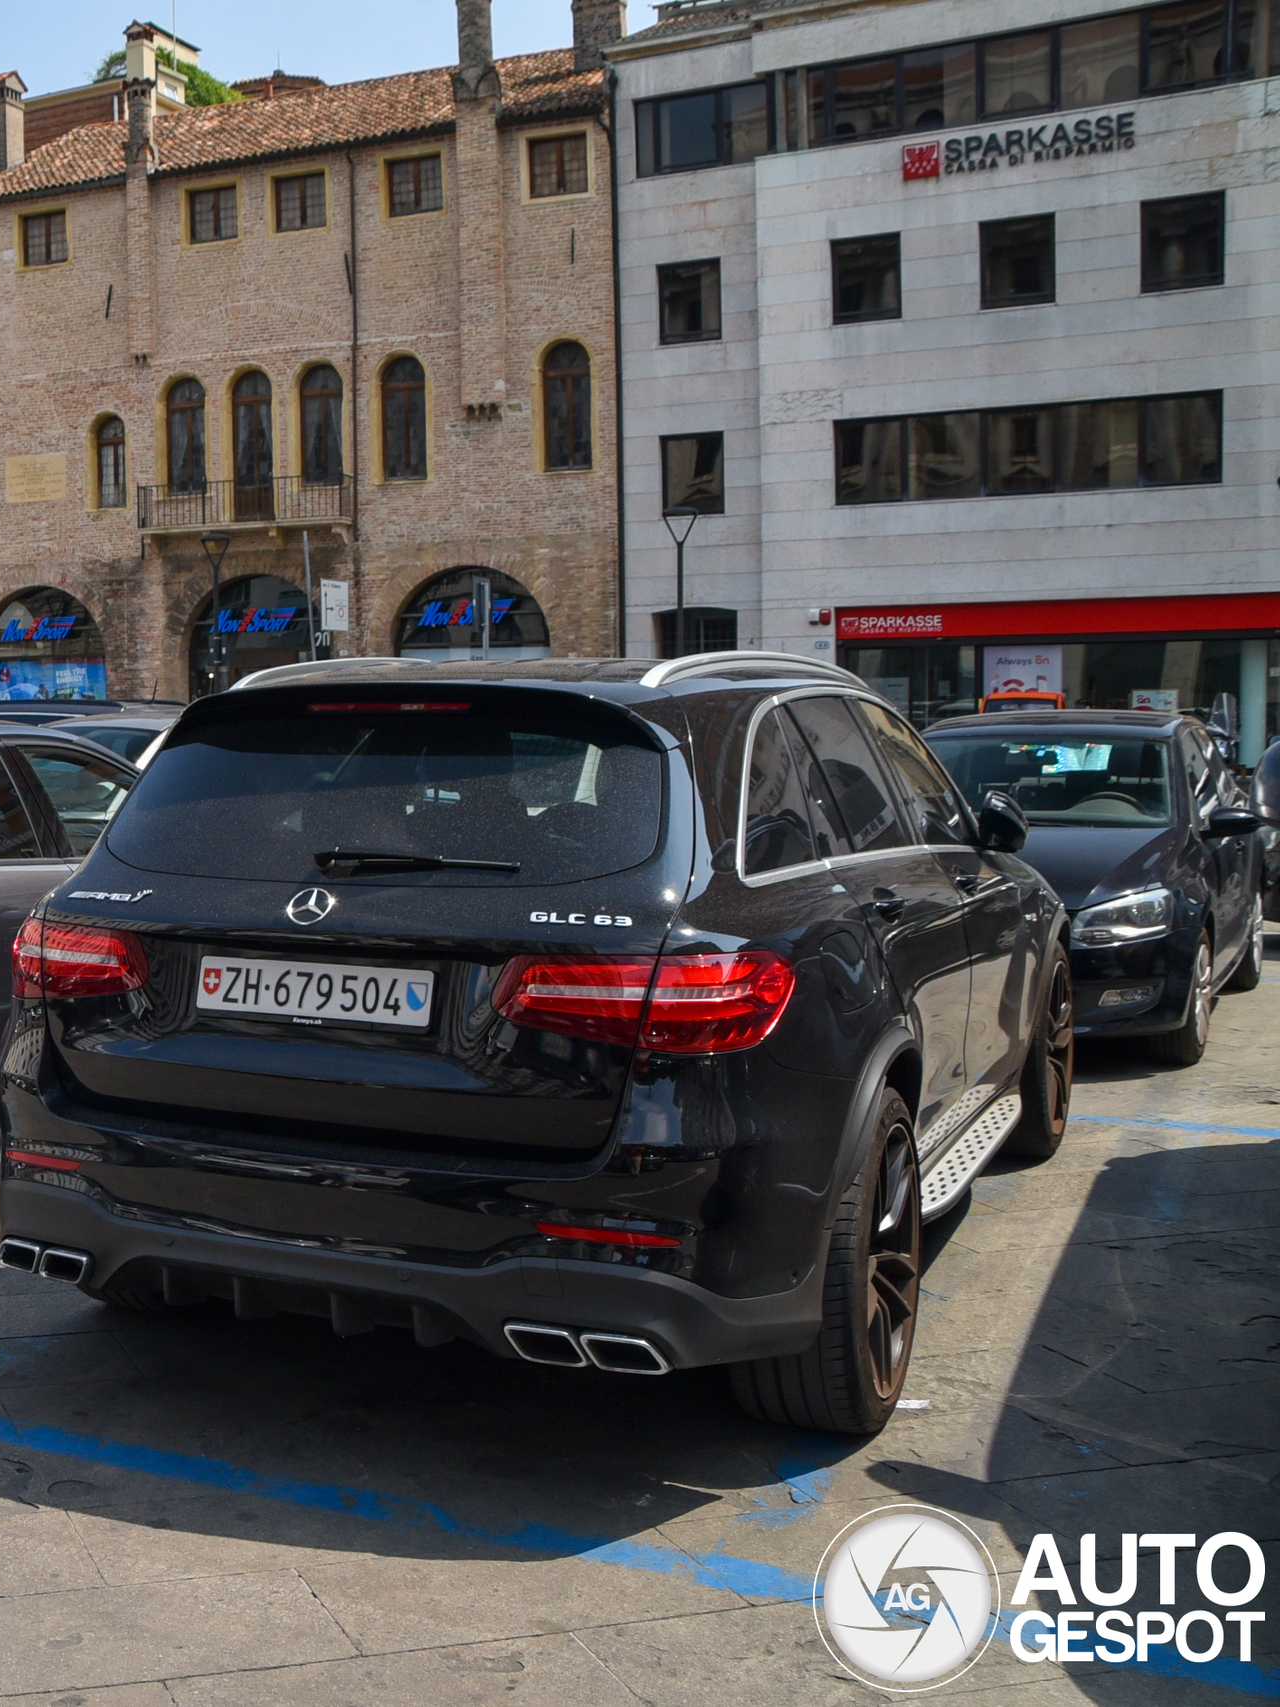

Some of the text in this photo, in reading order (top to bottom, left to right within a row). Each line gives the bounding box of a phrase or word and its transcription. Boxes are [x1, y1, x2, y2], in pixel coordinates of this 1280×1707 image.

[944, 111, 1136, 162] SPARKASSE
[944, 137, 1136, 175] CASSA DI RISPARMIO
[860, 615, 943, 628] SPARKASSE
[898, 625, 943, 633] RISPARMIO
[996, 656, 1033, 667] Always
[529, 911, 633, 927] GLC 63
